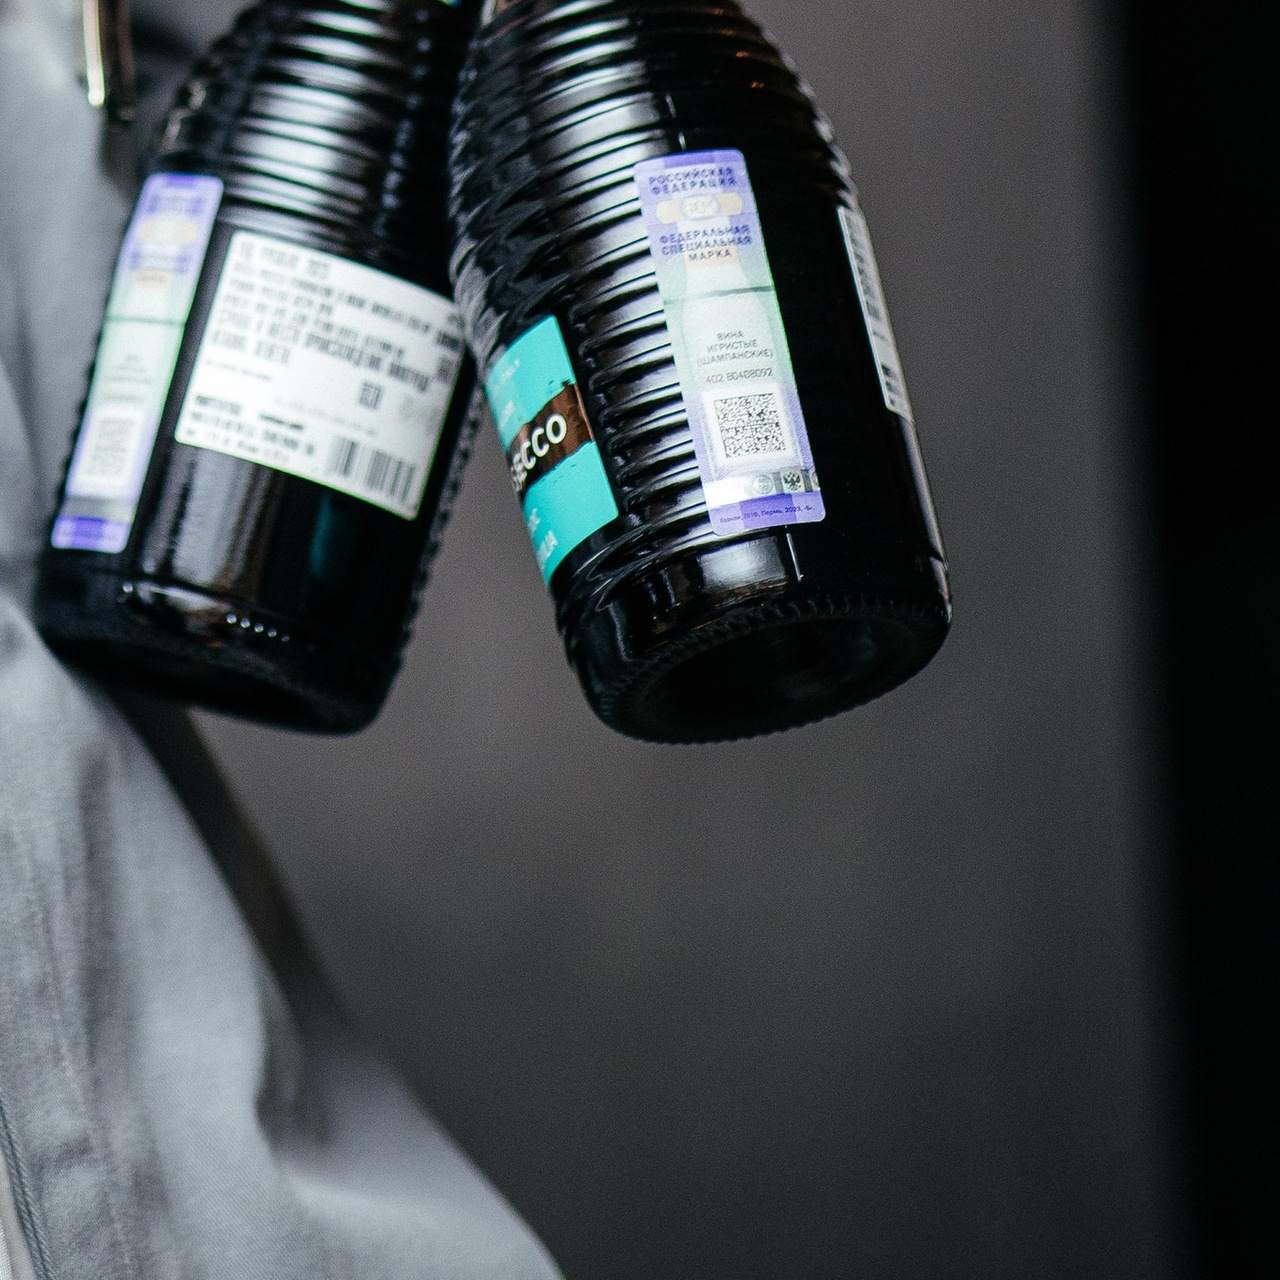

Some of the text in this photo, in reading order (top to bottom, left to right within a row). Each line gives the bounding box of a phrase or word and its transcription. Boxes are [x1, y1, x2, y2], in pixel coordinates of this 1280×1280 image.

[648, 166, 733, 186] РОССИЙСКАЯ
[651, 177, 737, 195] ФЕДЕРАЦИЯ
[659, 225, 750, 244] ФЕДЕРАЛЬНАЯ
[661, 235, 753, 256] СПЕЦИАЛЬНАЯ
[688, 249, 732, 262] МАРКА
[717, 330, 744, 341] ВИНА
[707, 339, 758, 353] ИГРИСТЫЕ
[696, 348, 774, 367] (ШАМПАНСКИЕ)
